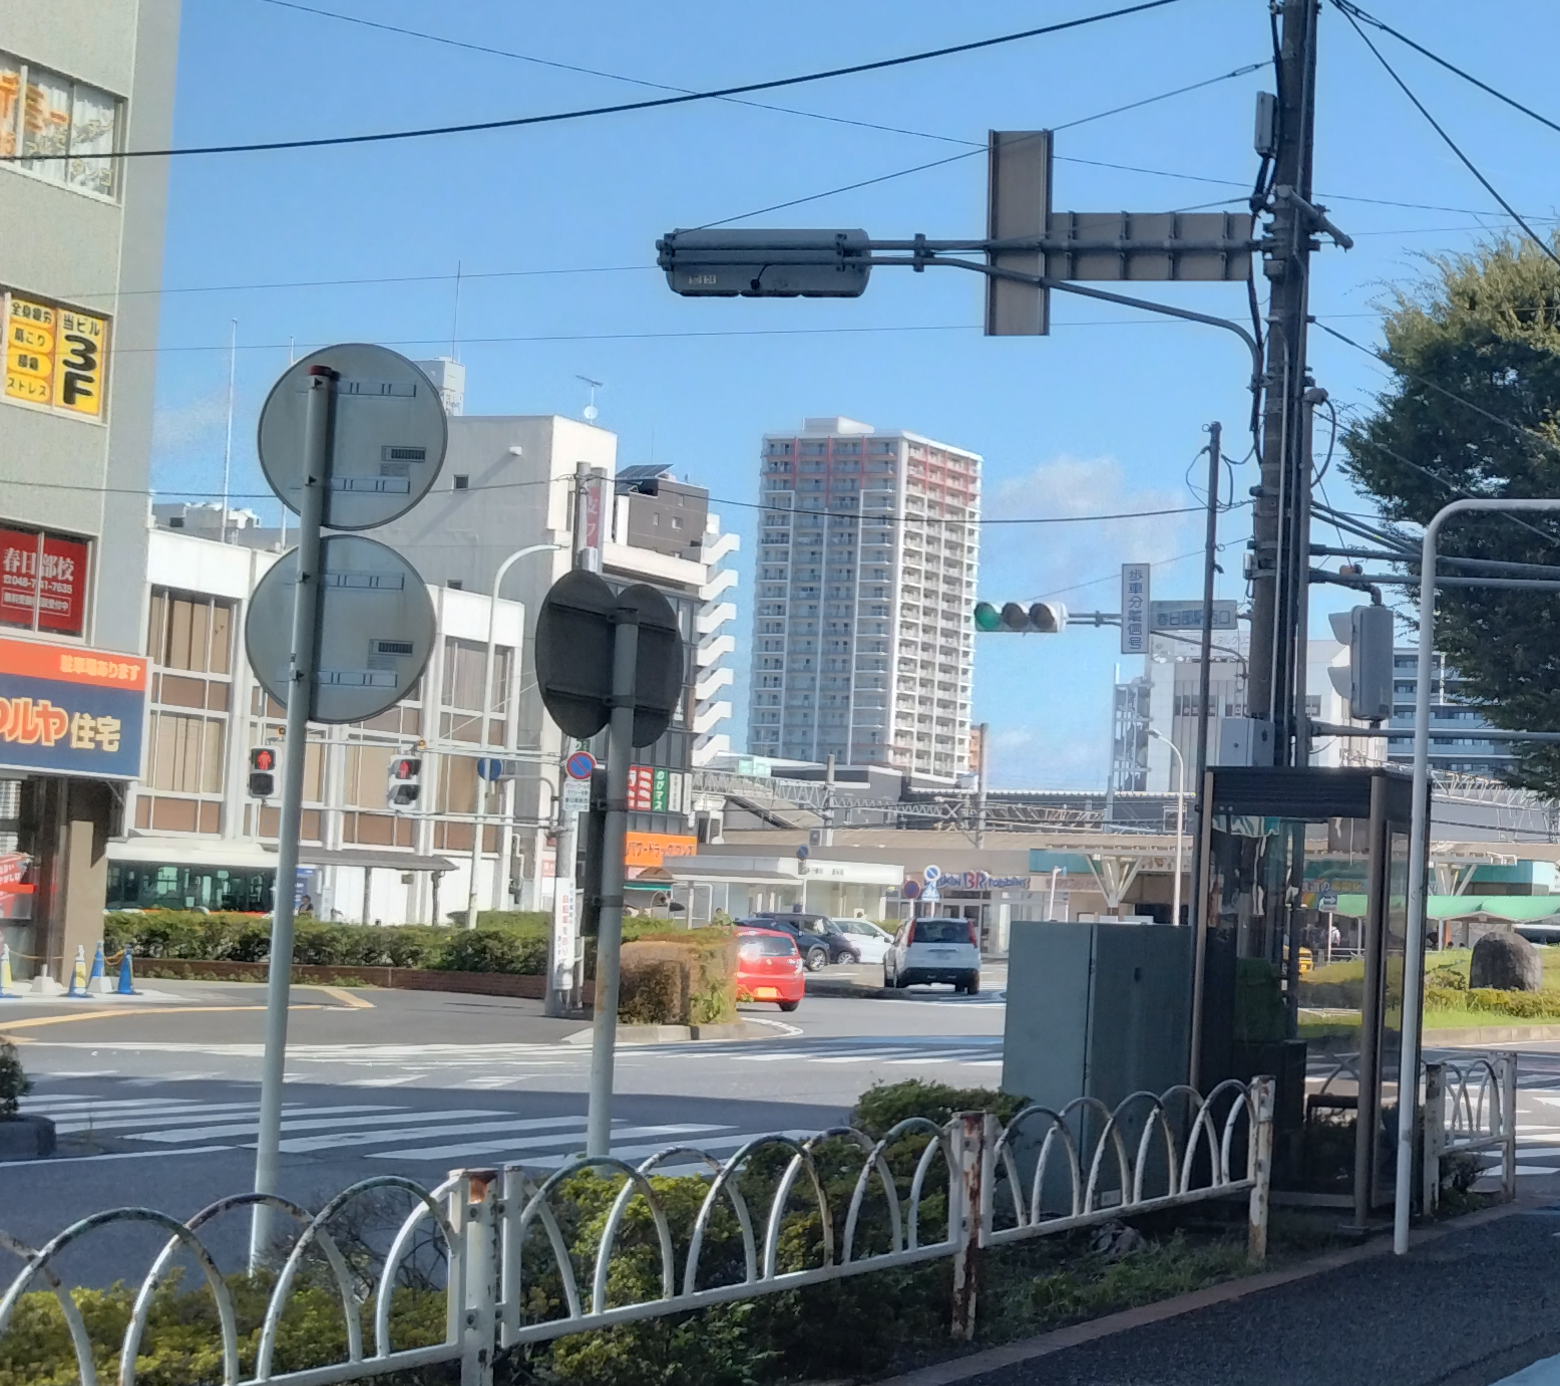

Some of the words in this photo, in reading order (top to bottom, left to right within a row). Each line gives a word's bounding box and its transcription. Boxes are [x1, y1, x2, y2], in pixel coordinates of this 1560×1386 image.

[63, 313, 101, 336] 当ビル
[62, 333, 98, 405] 3F
[7, 376, 47, 397] ストレス
[2, 547, 74, 582] 春日部校
